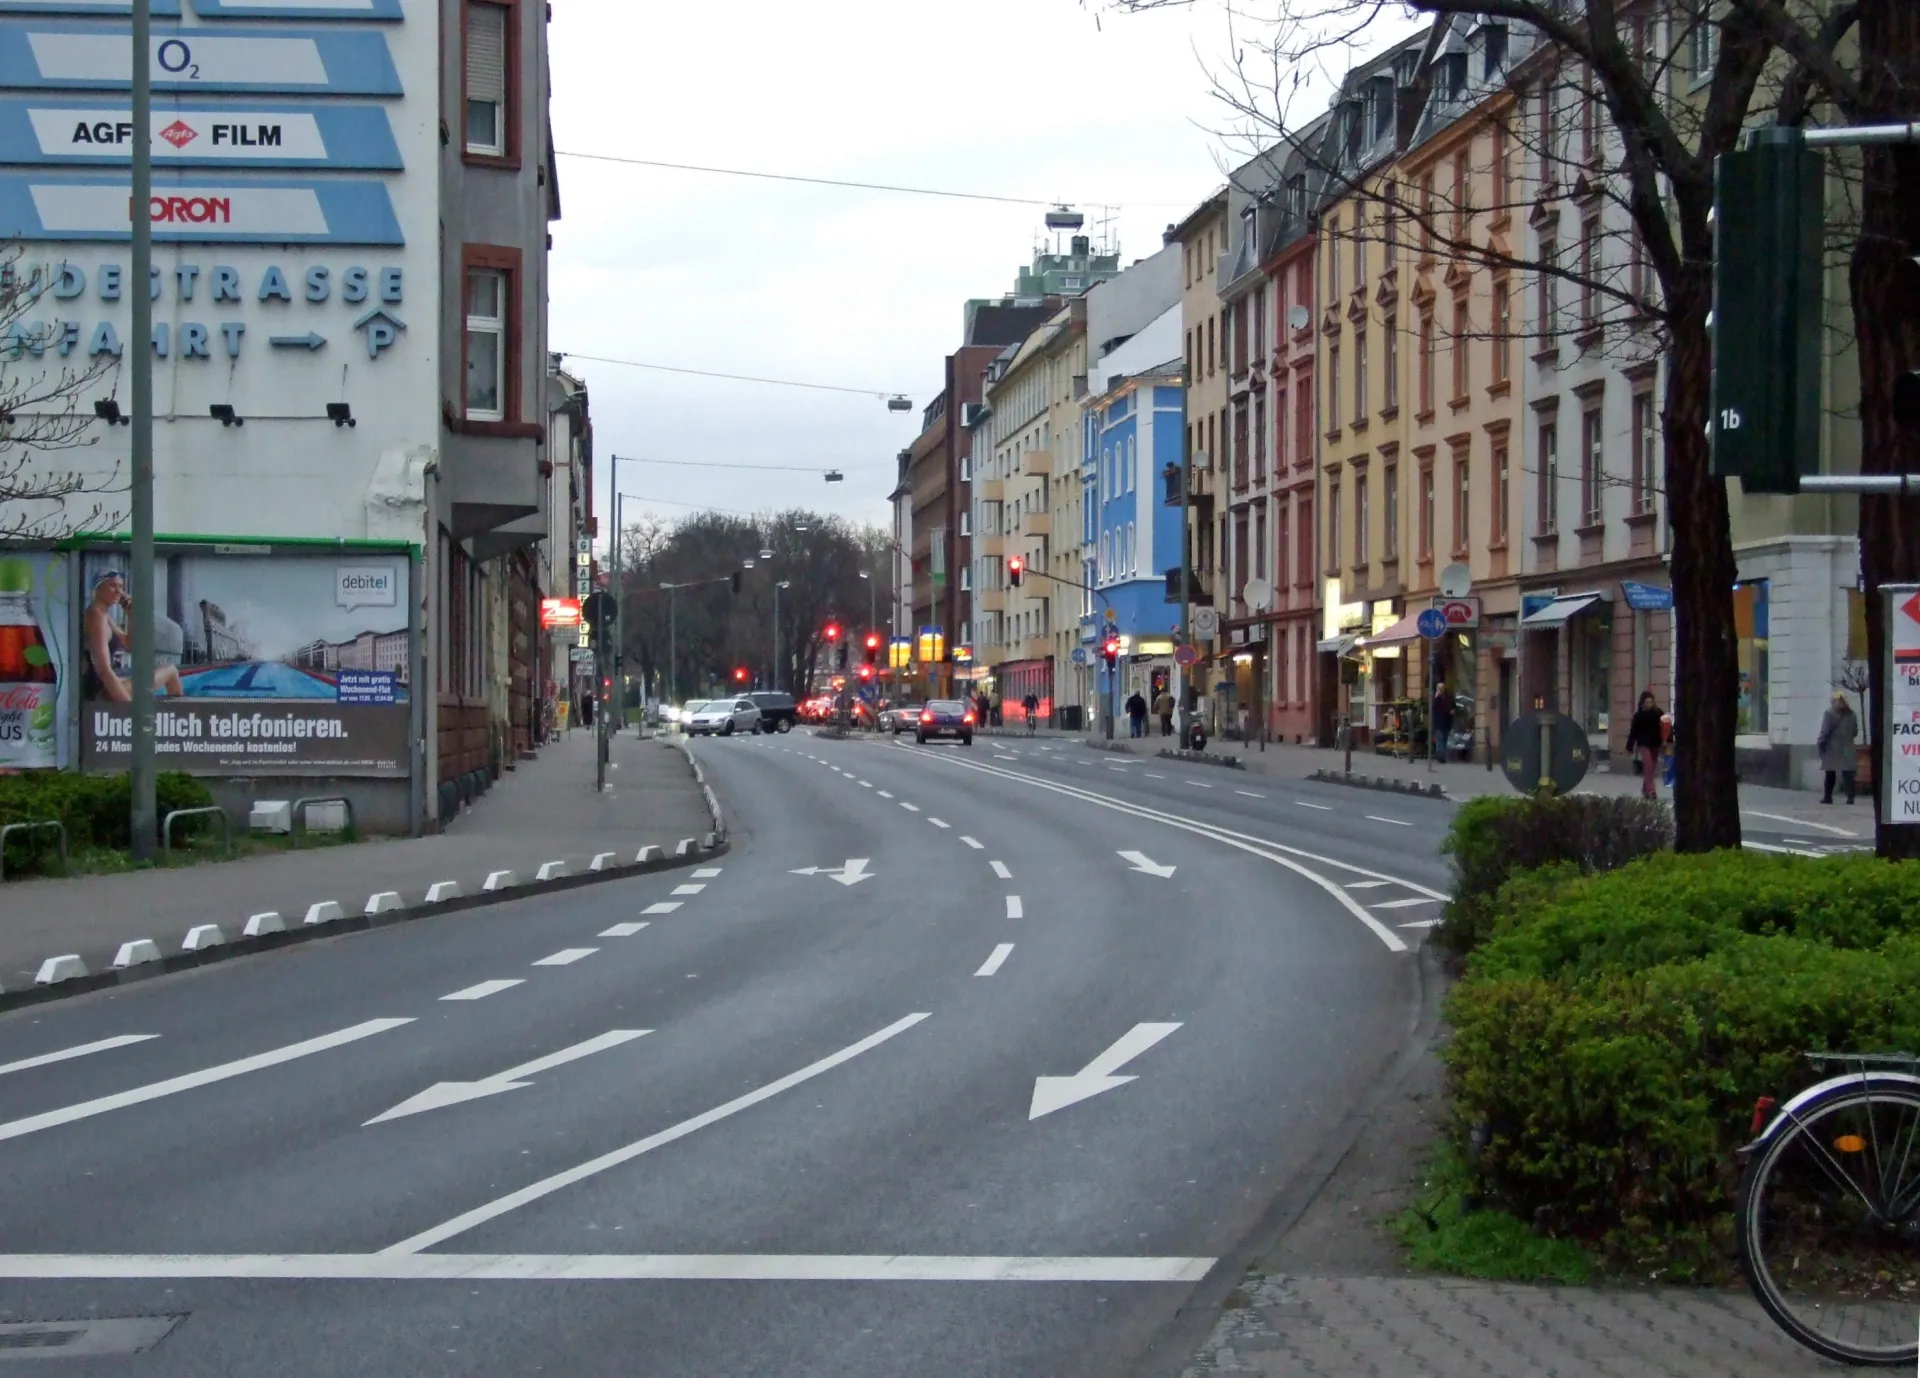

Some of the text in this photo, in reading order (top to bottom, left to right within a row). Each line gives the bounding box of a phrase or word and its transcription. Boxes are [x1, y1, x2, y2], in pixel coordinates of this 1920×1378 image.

[157, 39, 200, 79] O2
[72, 122, 282, 146] AGF Agfa FILM
[129, 196, 230, 223] ORON
[1720, 408, 1740, 430] 1b
[342, 574, 388, 589] debitel
[209, 713, 349, 738] telefonieren.
[96, 741, 108, 753] 24
[154, 741, 181, 754] jedes
[183, 741, 245, 753] Wochenende
[247, 741, 297, 753] kostenlos!
